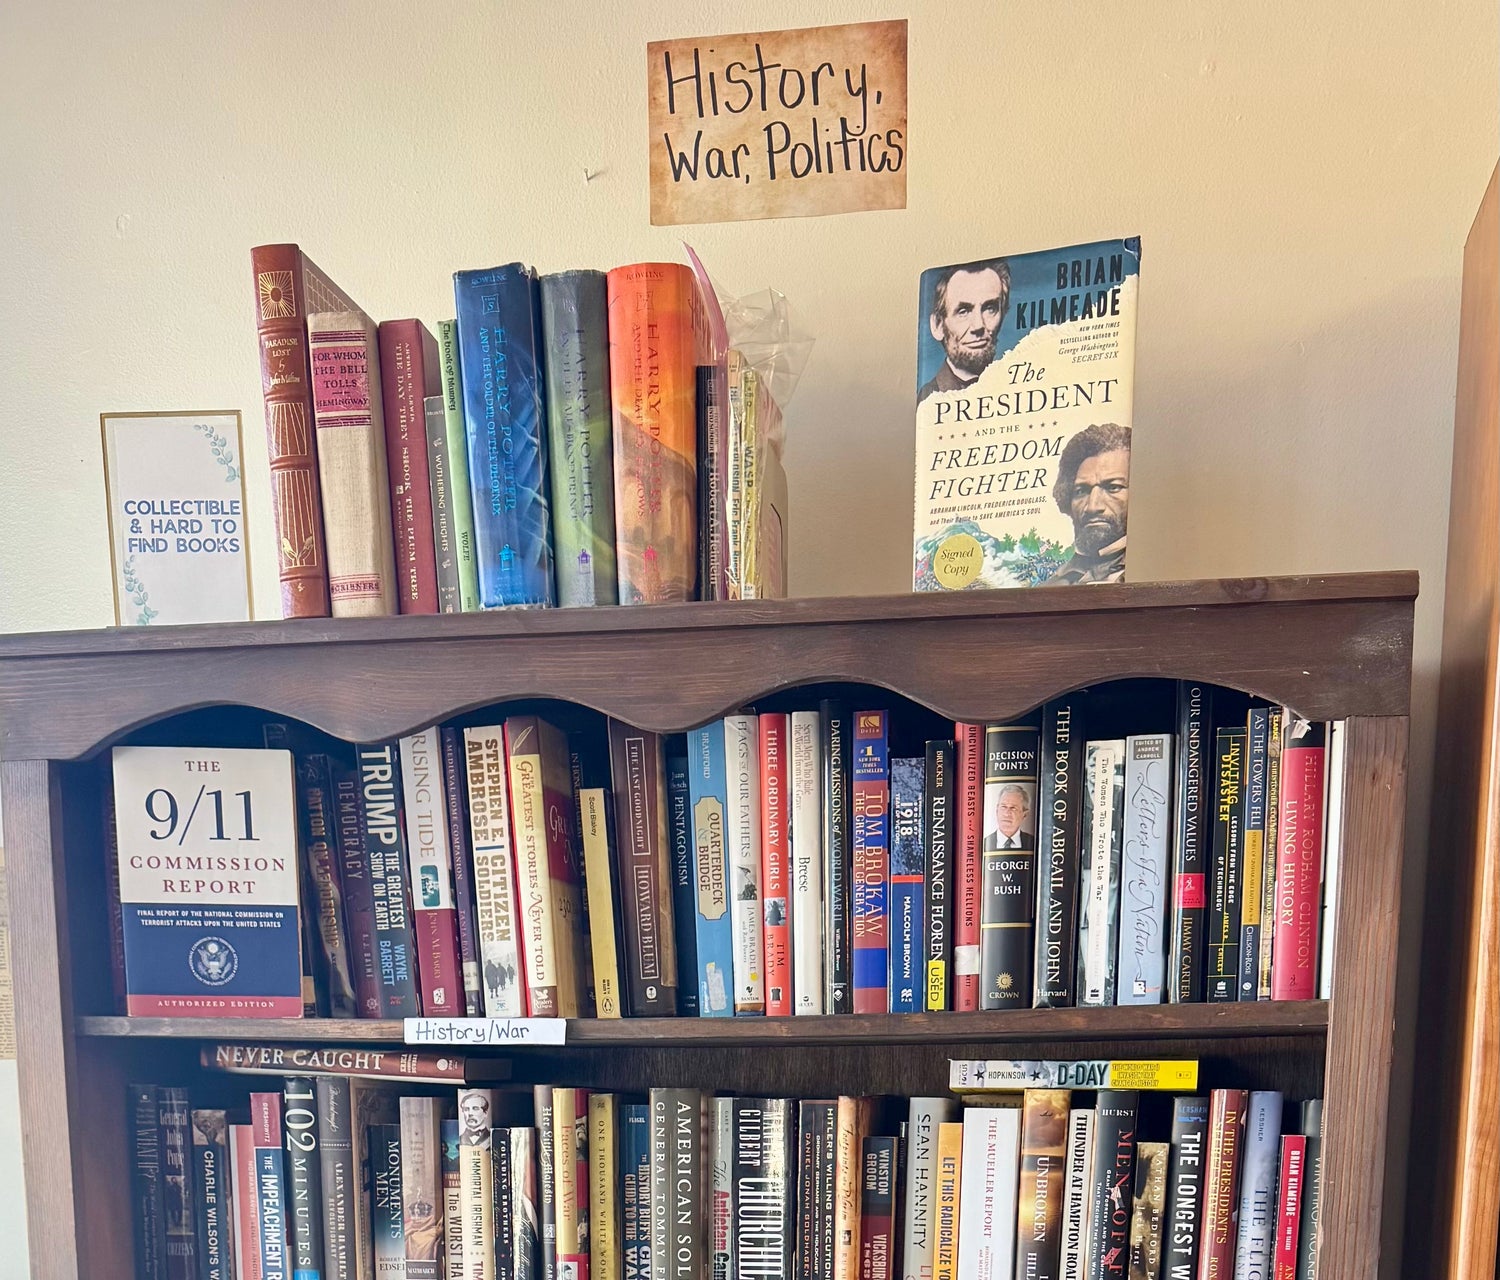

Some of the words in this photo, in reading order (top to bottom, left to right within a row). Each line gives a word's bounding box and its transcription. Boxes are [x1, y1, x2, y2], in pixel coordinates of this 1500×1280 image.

[664, 44, 884, 134] History,
[664, 130, 751, 185] War,
[766, 116, 904, 180] Politics
[1057, 254, 1122, 289] BRIAN
[1017, 289, 1120, 329] KILMEADE
[313, 350, 331, 362] FOR
[333, 350, 367, 362] WHOM
[314, 364, 337, 376] THE
[339, 364, 368, 374] BELL
[1008, 361, 1046, 384] The
[324, 378, 357, 389] TOLLS
[935, 379, 1118, 425] PRESIDENT
[975, 428, 996, 437] AND
[1000, 425, 1020, 433] THE
[930, 436, 1065, 471] FREEDOM
[929, 468, 1048, 500] FIGHTER
[124, 500, 240, 515] COLLECTIBLE
[130, 518, 142, 534] &
[151, 519, 202, 534] HARD
[212, 520, 236, 534] TO
[128, 538, 168, 552] FIND
[177, 538, 240, 553] BOOKS
[941, 548, 974, 561] Signed
[943, 564, 970, 575] Copy
[1057, 707, 1070, 743] THE
[184, 760, 221, 772] THE
[989, 750, 1034, 762] DECISION
[994, 761, 1029, 771] POINTS
[1056, 750, 1068, 794] BOOK
[361, 746, 397, 844] TRUMP
[468, 741, 490, 840] AMBROSE
[485, 739, 502, 818] STEPHEN
[145, 784, 260, 845] 9/11
[865, 791, 883, 840] TOM
[1054, 800, 1066, 820] OF
[490, 826, 504, 841] E.
[1283, 801, 1297, 854] LIVING
[130, 856, 285, 871] COMMISSION
[370, 852, 384, 880] SHOW
[385, 851, 399, 867] THE
[987, 860, 1029, 872] GEORGE
[1052, 826, 1065, 893] ABIGAIL
[162, 880, 256, 894] REPORT
[373, 883, 386, 897] ON
[865, 847, 884, 936] BROKAW
[994, 885, 1021, 895] BUSH
[1002, 873, 1013, 882] W.
[386, 870, 405, 928] GREATEST
[476, 857, 494, 942] SOLDIERS
[490, 855, 511, 942] CITIZEN
[1282, 864, 1295, 926] HISTORY
[373, 899, 389, 930] EARTH
[1050, 898, 1062, 934] AND
[1047, 938, 1061, 983] JOHN
[1037, 989, 1066, 997] Harvard
[416, 1024, 530, 1044] History/War
[216, 1046, 283, 1065] NEVER
[293, 1049, 384, 1071] CAUGHT
[1057, 1064, 1108, 1085] D-DAY
[988, 1071, 1026, 1080] HOPKINSON
[283, 1089, 315, 1152] 102
[917, 1114, 930, 1161] SEAN
[1180, 1132, 1201, 1173] THE
[677, 1102, 691, 1226] AMERICAN
[293, 1158, 310, 1266] MINUTES
[914, 1169, 927, 1249] HANNITY
[1036, 1157, 1050, 1242] UNBROKEN
[1174, 1174, 1199, 1259] LONGEST
